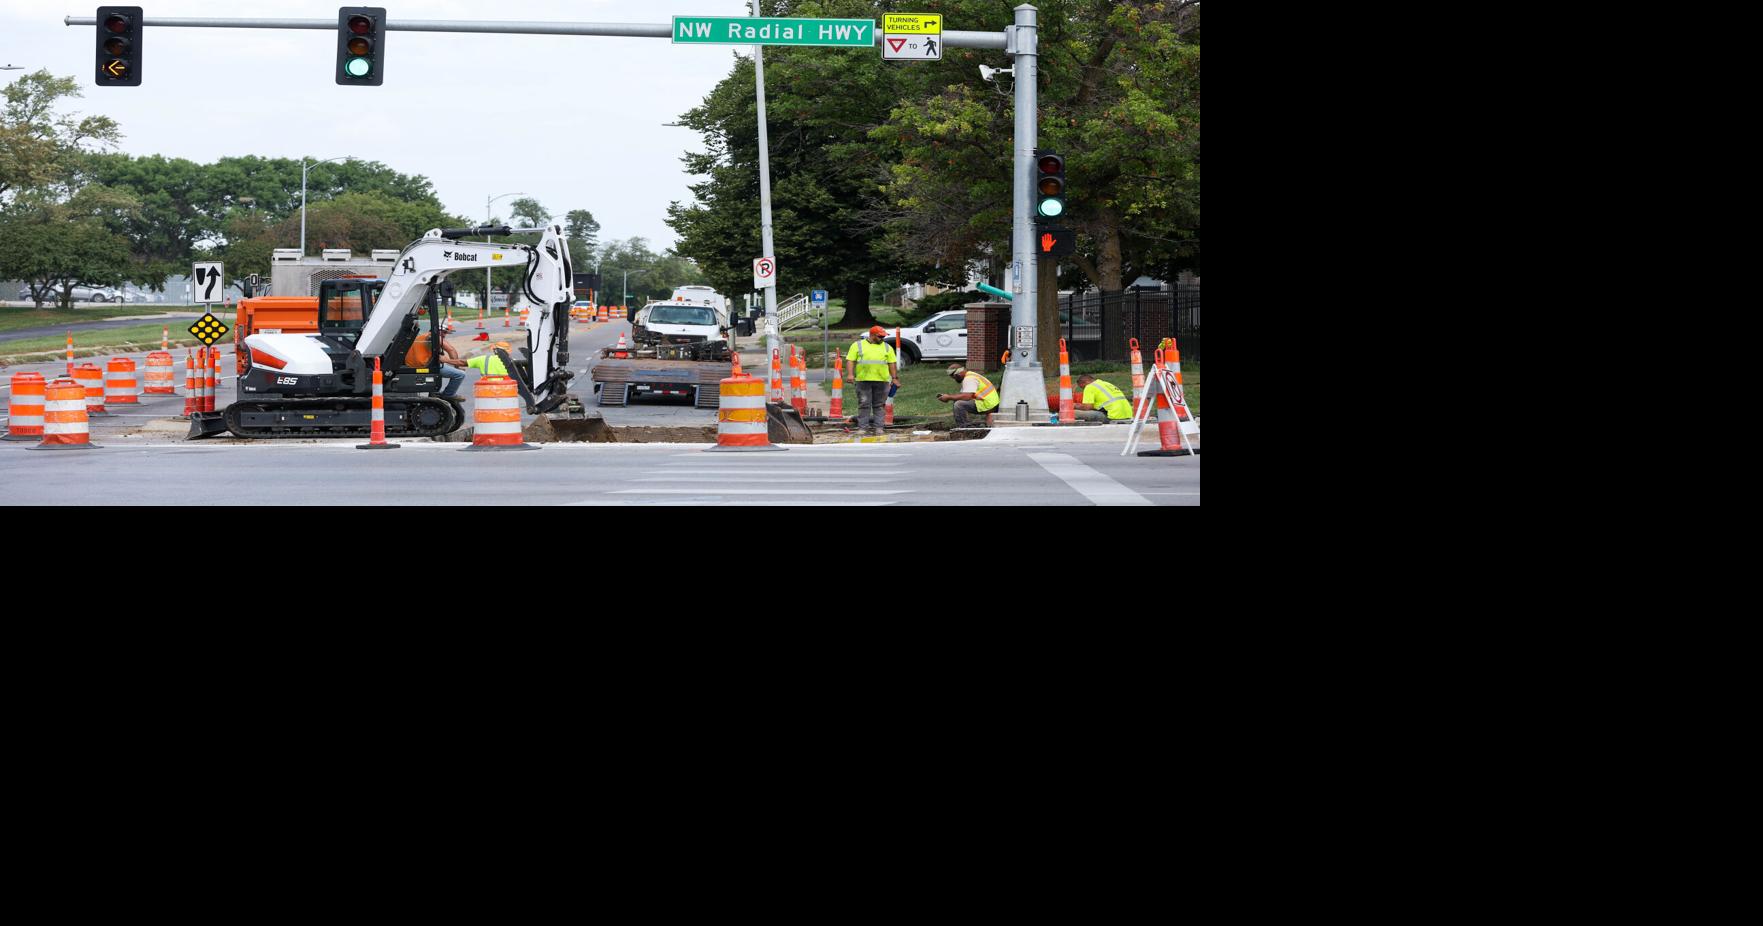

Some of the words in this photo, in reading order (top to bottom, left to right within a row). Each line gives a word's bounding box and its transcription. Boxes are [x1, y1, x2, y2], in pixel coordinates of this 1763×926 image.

[679, 22, 712, 38] NW
[728, 23, 803, 39] Radial
[818, 24, 868, 41] HWY
[454, 252, 477, 261] Bobcat
[276, 376, 298, 385] E85
